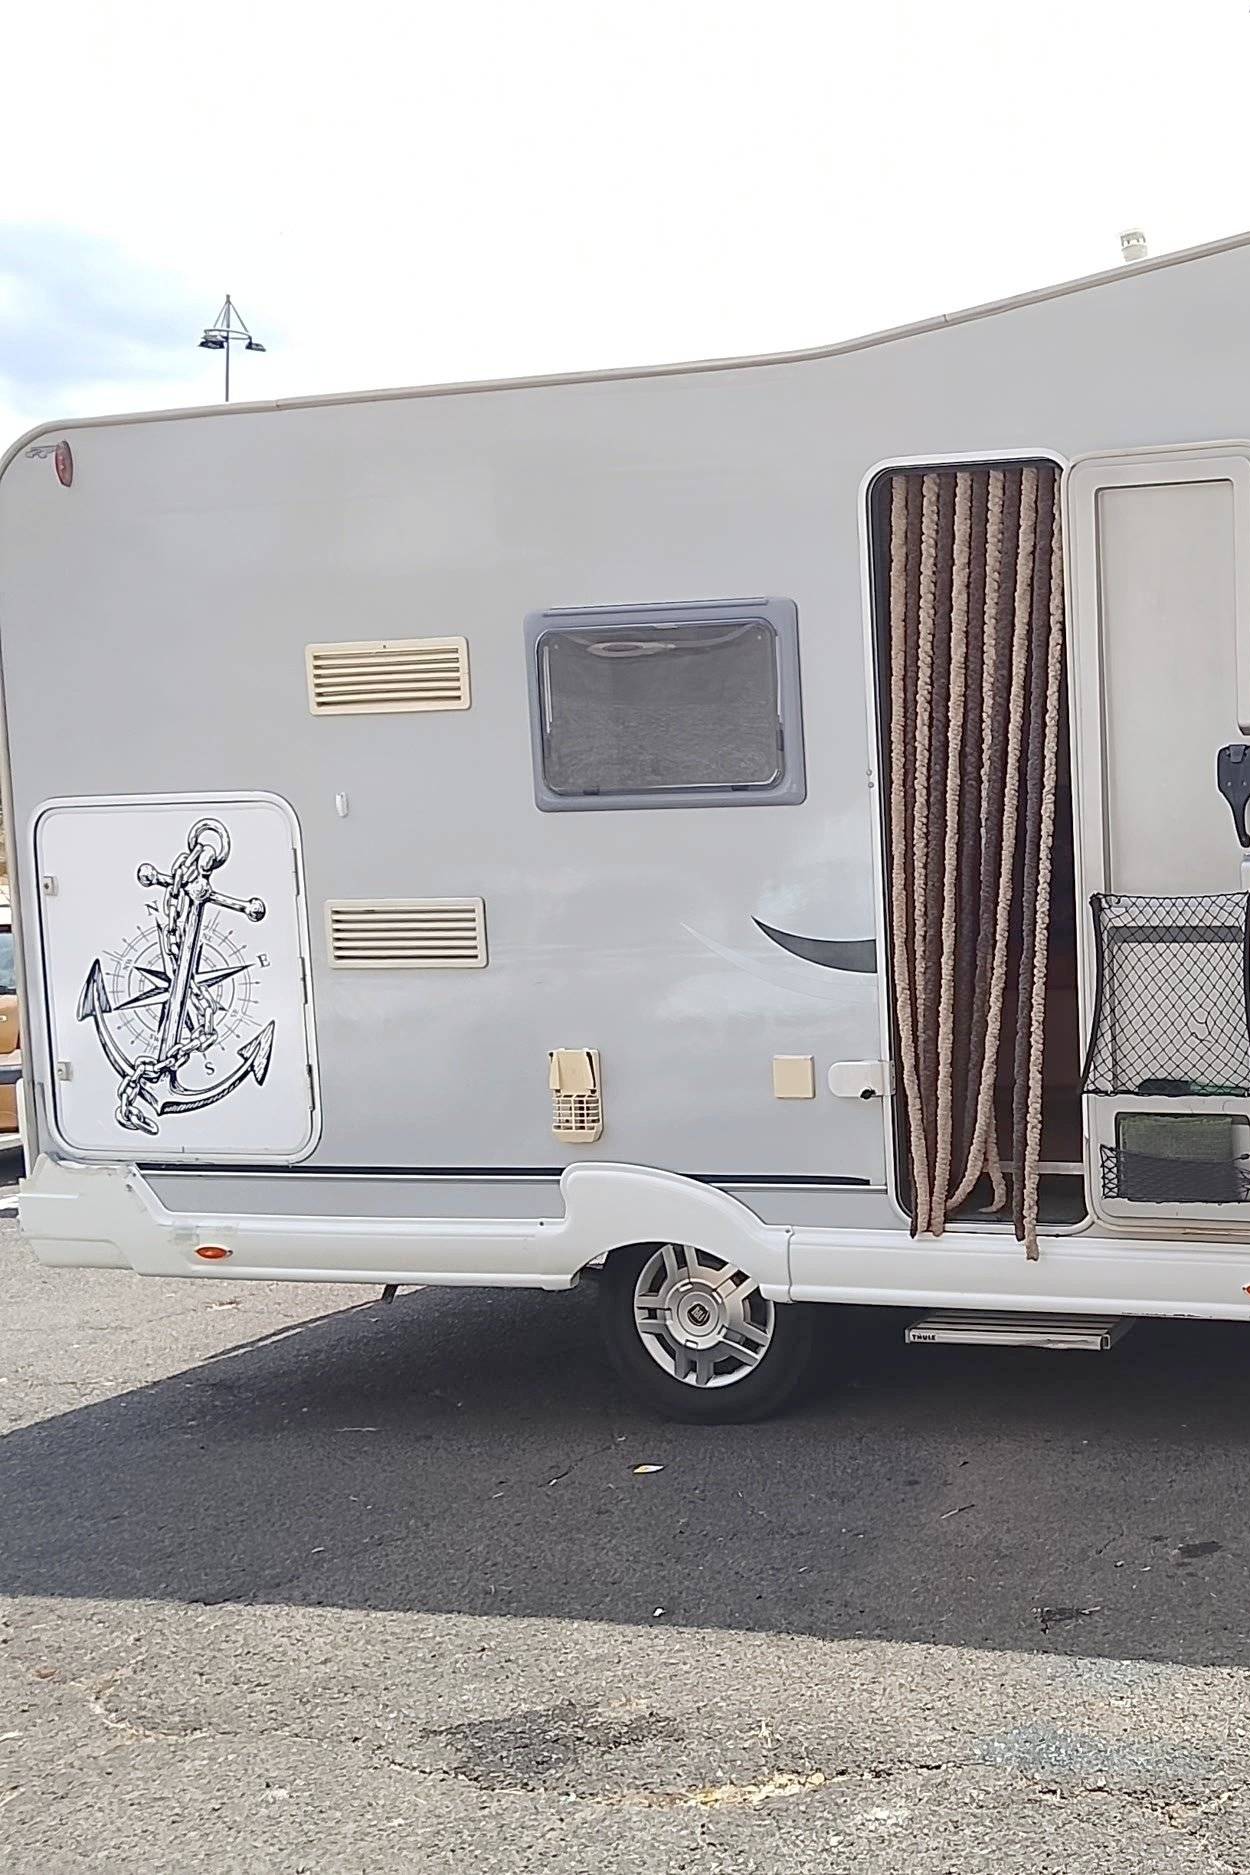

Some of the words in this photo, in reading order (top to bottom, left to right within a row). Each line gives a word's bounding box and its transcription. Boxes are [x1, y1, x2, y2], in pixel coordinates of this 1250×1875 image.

[145, 900, 160, 917] N
[257, 953, 271, 969] E
[204, 1061, 216, 1076] S
